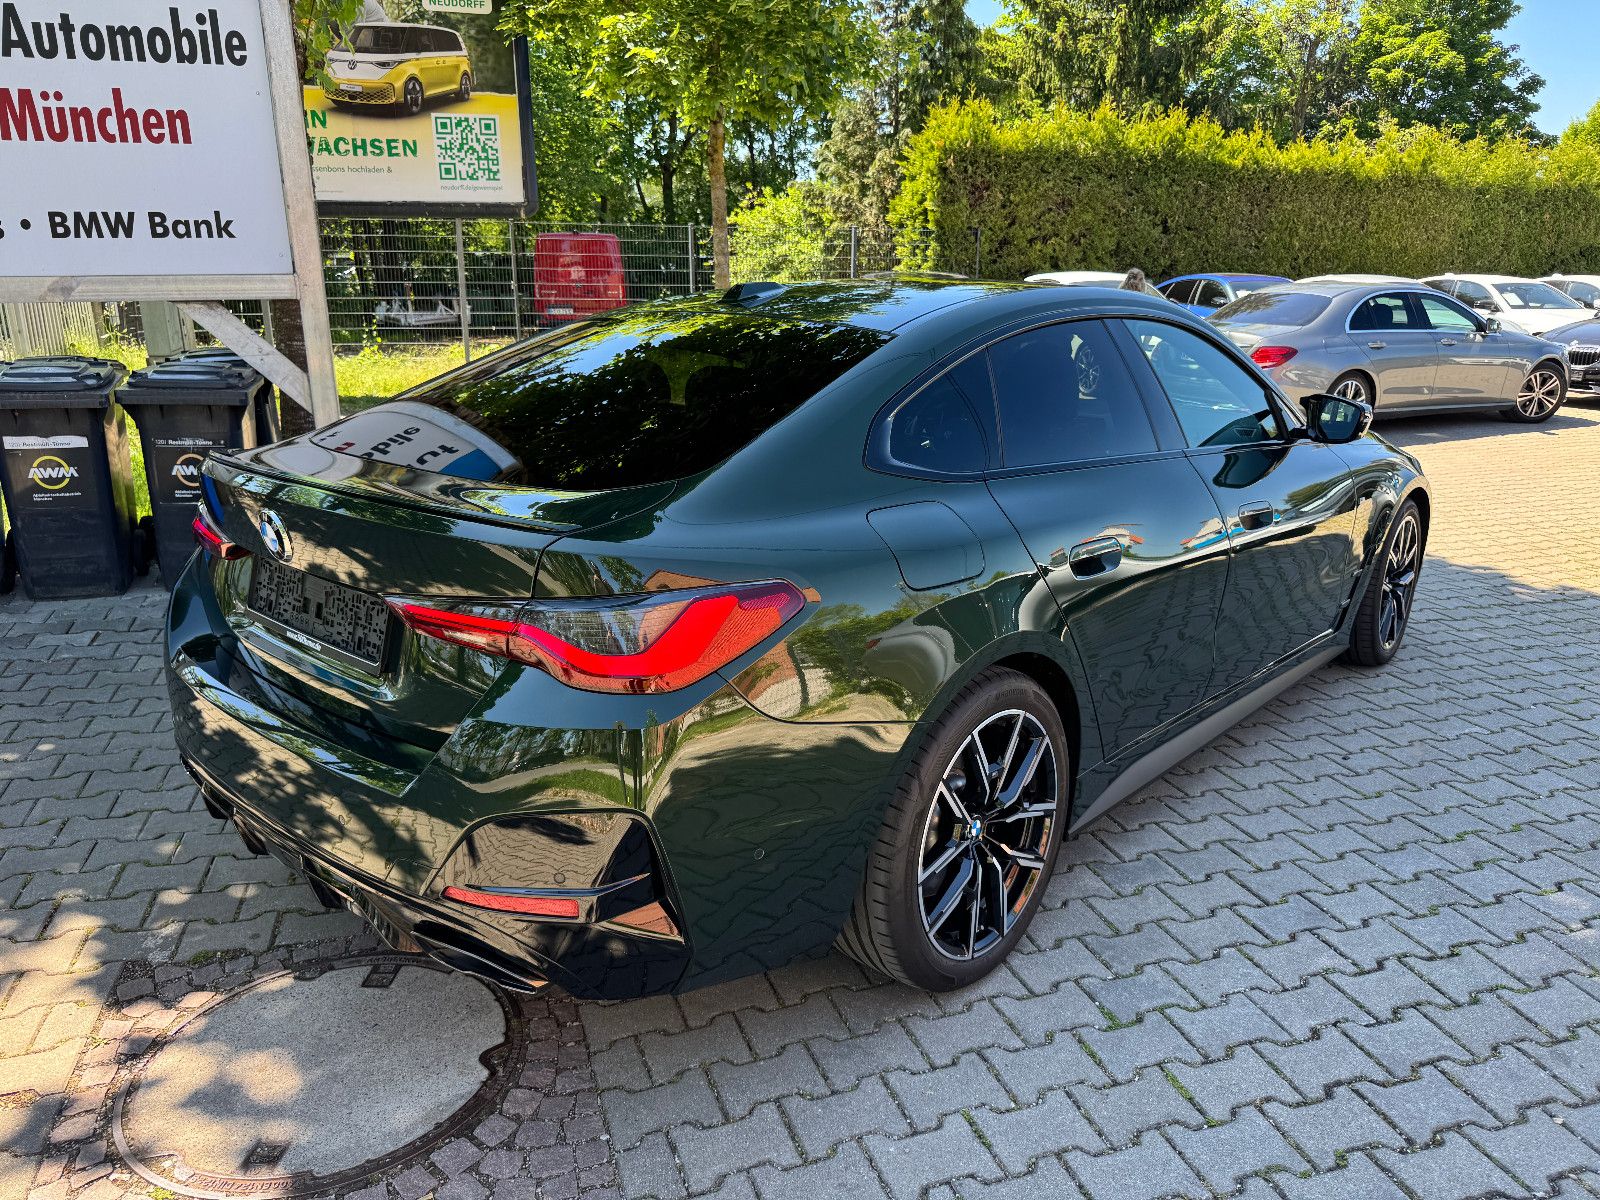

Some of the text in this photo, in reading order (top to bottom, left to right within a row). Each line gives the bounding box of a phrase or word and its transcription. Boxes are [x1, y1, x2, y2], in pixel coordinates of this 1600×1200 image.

[429, 0, 486, 9] NEUDORFF
[1, 2, 247, 66] Automobile
[0, 87, 192, 144] München
[348, 165, 385, 174] hochladen
[387, 166, 393, 174] &
[48, 210, 237, 239] BMW Bank
[28, 466, 79, 478] AWM
[172, 464, 198, 476] AW
